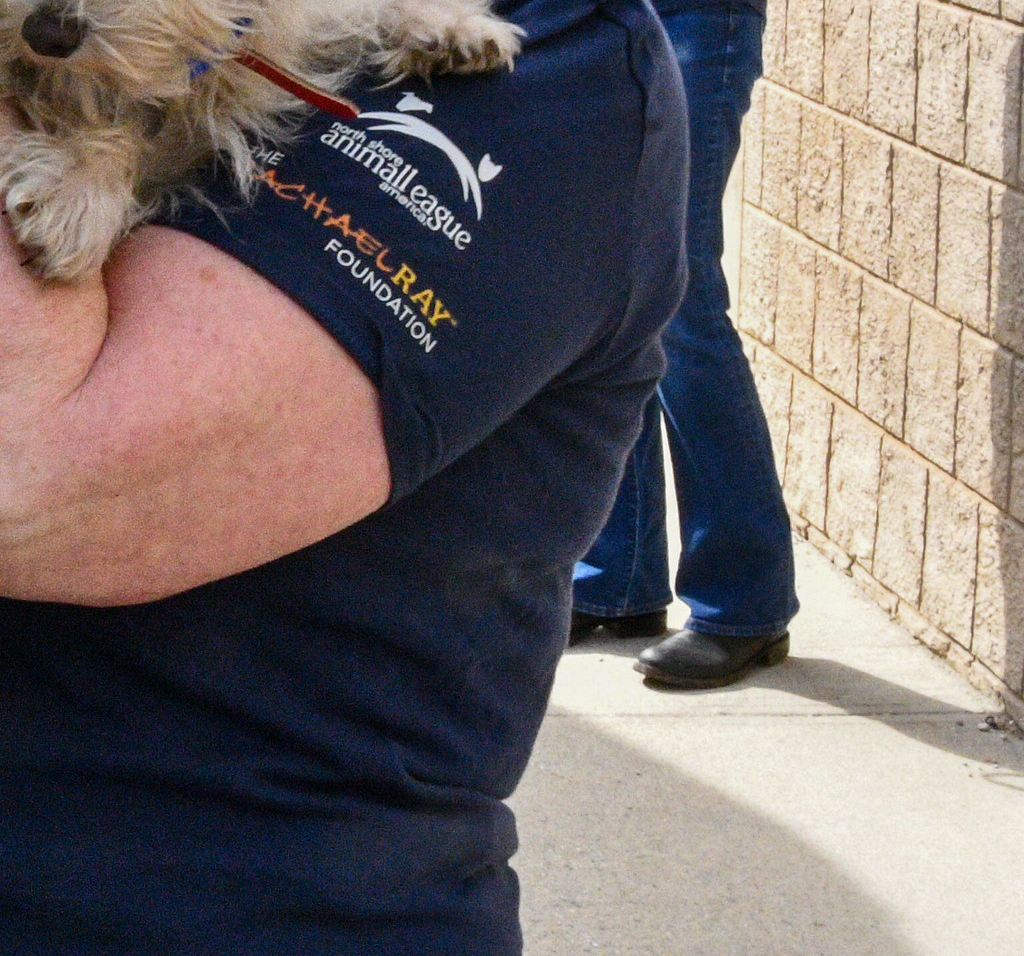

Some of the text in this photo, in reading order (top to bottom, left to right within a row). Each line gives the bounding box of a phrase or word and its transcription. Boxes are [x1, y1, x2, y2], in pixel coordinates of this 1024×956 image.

[330, 121, 404, 167] north shore
[379, 181, 427, 227] america
[252, 168, 451, 327] ACHAEL RAY
[323, 237, 439, 354] FOUNDATION
